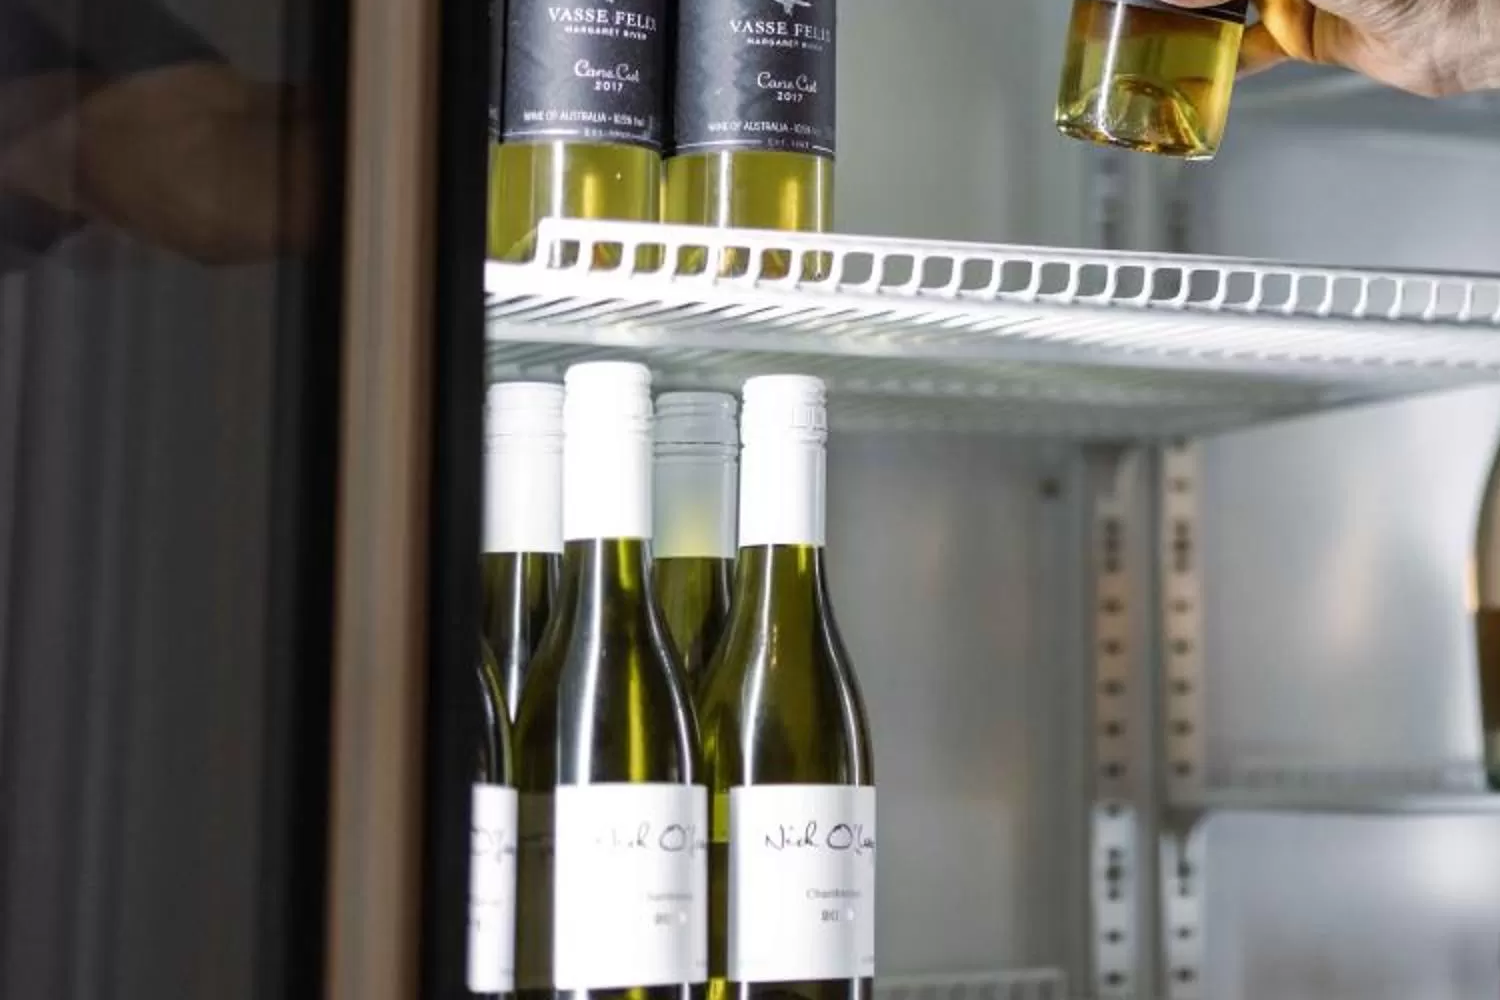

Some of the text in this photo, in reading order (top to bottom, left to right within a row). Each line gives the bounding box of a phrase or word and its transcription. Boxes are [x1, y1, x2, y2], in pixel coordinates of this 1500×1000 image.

[548, 6, 609, 24] VASSE
[565, 25, 619, 37] MARGARET
[729, 19, 788, 36] VASSE
[594, 80, 624, 93] 2017
[757, 70, 795, 90] Cane
[777, 90, 804, 103] 2017
[559, 109, 607, 124] AUSTRALIA
[743, 120, 789, 134] AUSTRALIA
